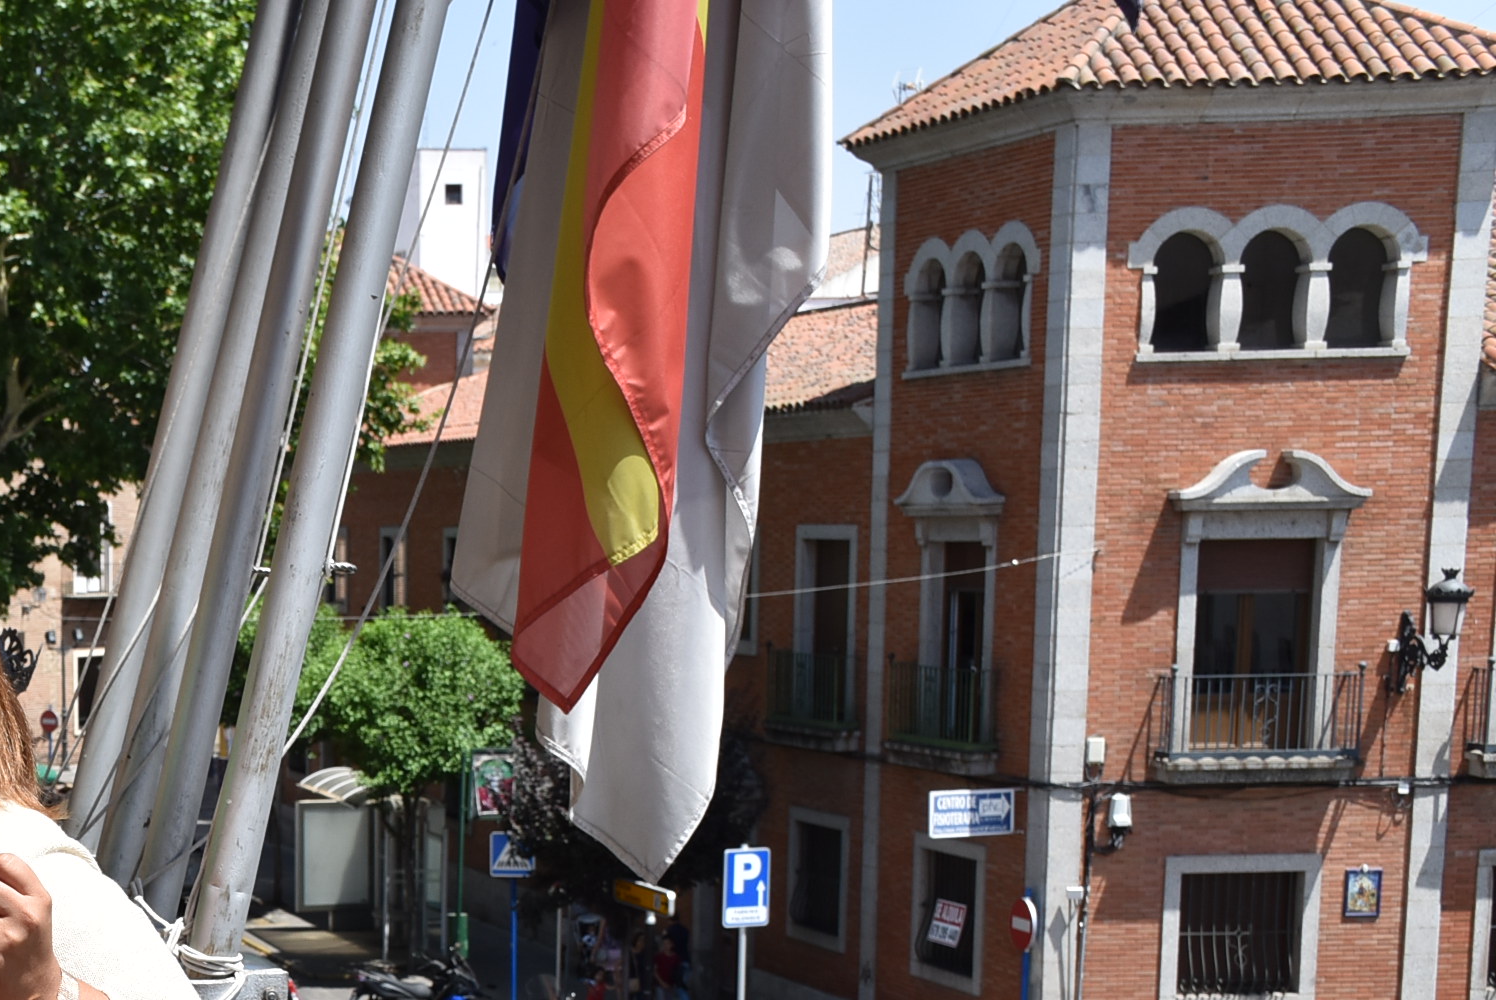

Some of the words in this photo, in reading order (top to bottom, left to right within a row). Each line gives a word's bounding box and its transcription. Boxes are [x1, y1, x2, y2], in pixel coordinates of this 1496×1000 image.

[937, 796, 965, 810] CENTRO
[967, 795, 977, 808] DE
[933, 812, 980, 826] FISIOTERAPIA
[733, 853, 762, 894] P
